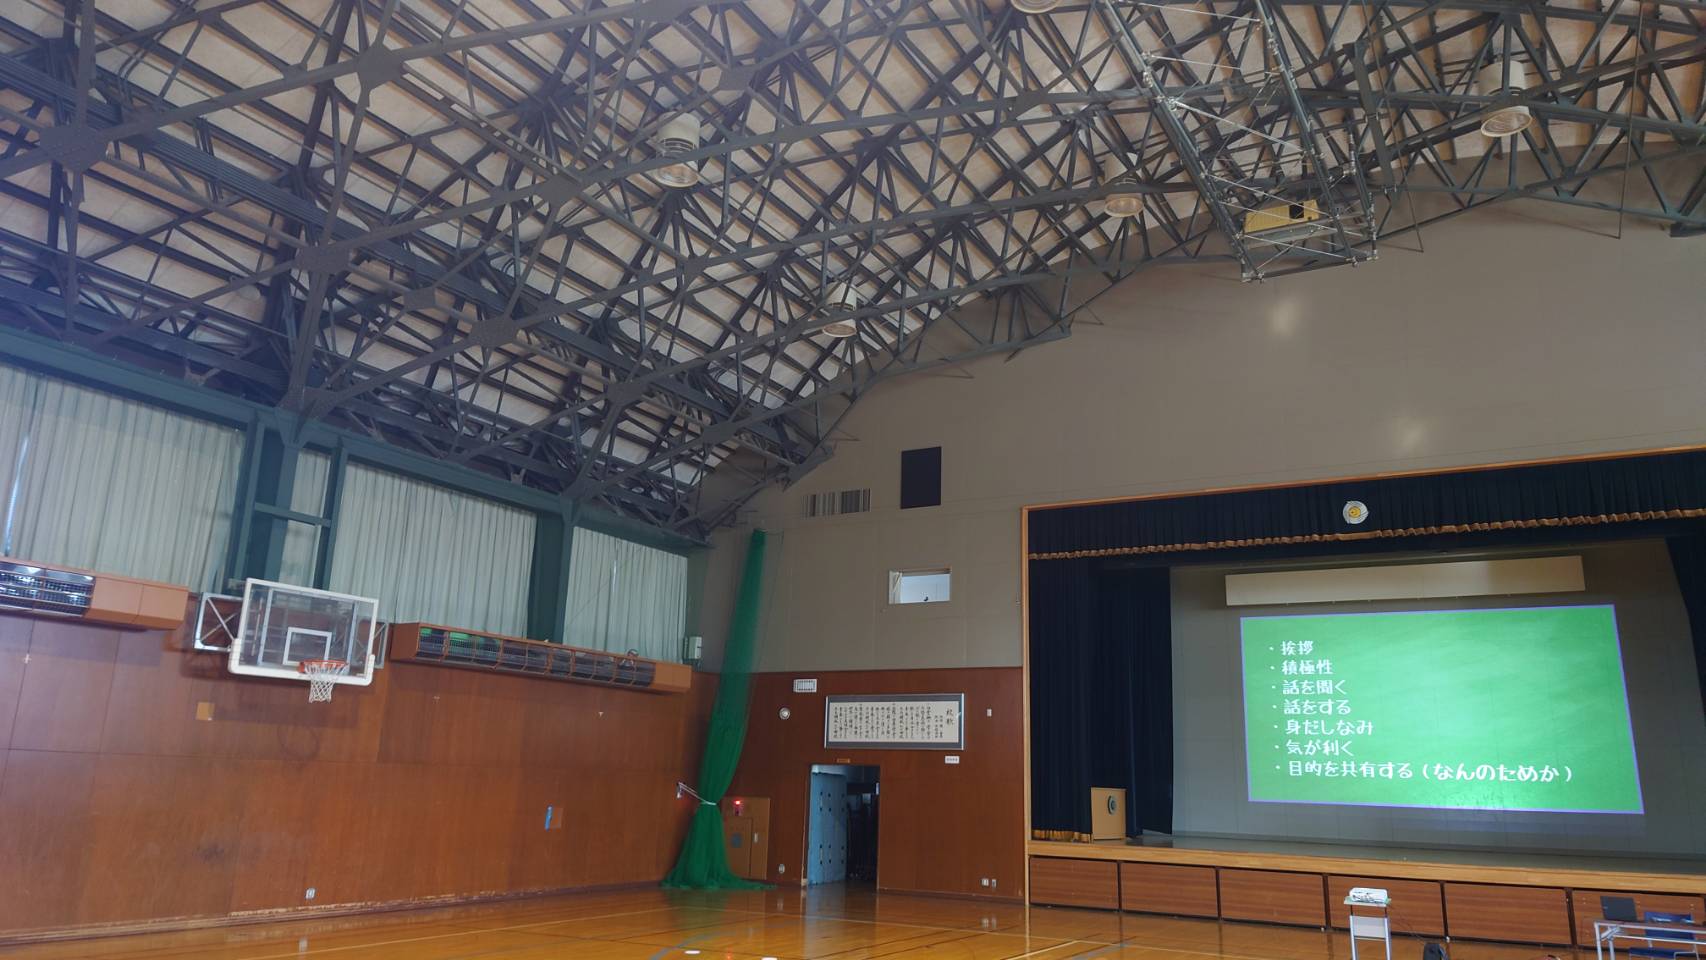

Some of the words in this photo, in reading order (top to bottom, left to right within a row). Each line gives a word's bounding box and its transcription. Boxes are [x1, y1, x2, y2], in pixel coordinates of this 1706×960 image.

[1280, 640, 1313, 656] 挨拶
[1281, 659, 1334, 675] 積極性
[1282, 679, 1347, 695] 話を聞く
[1283, 699, 1351, 715] 話をする
[1285, 719, 1373, 736] 身だしなみ
[1286, 739, 1354, 756] 気が利く
